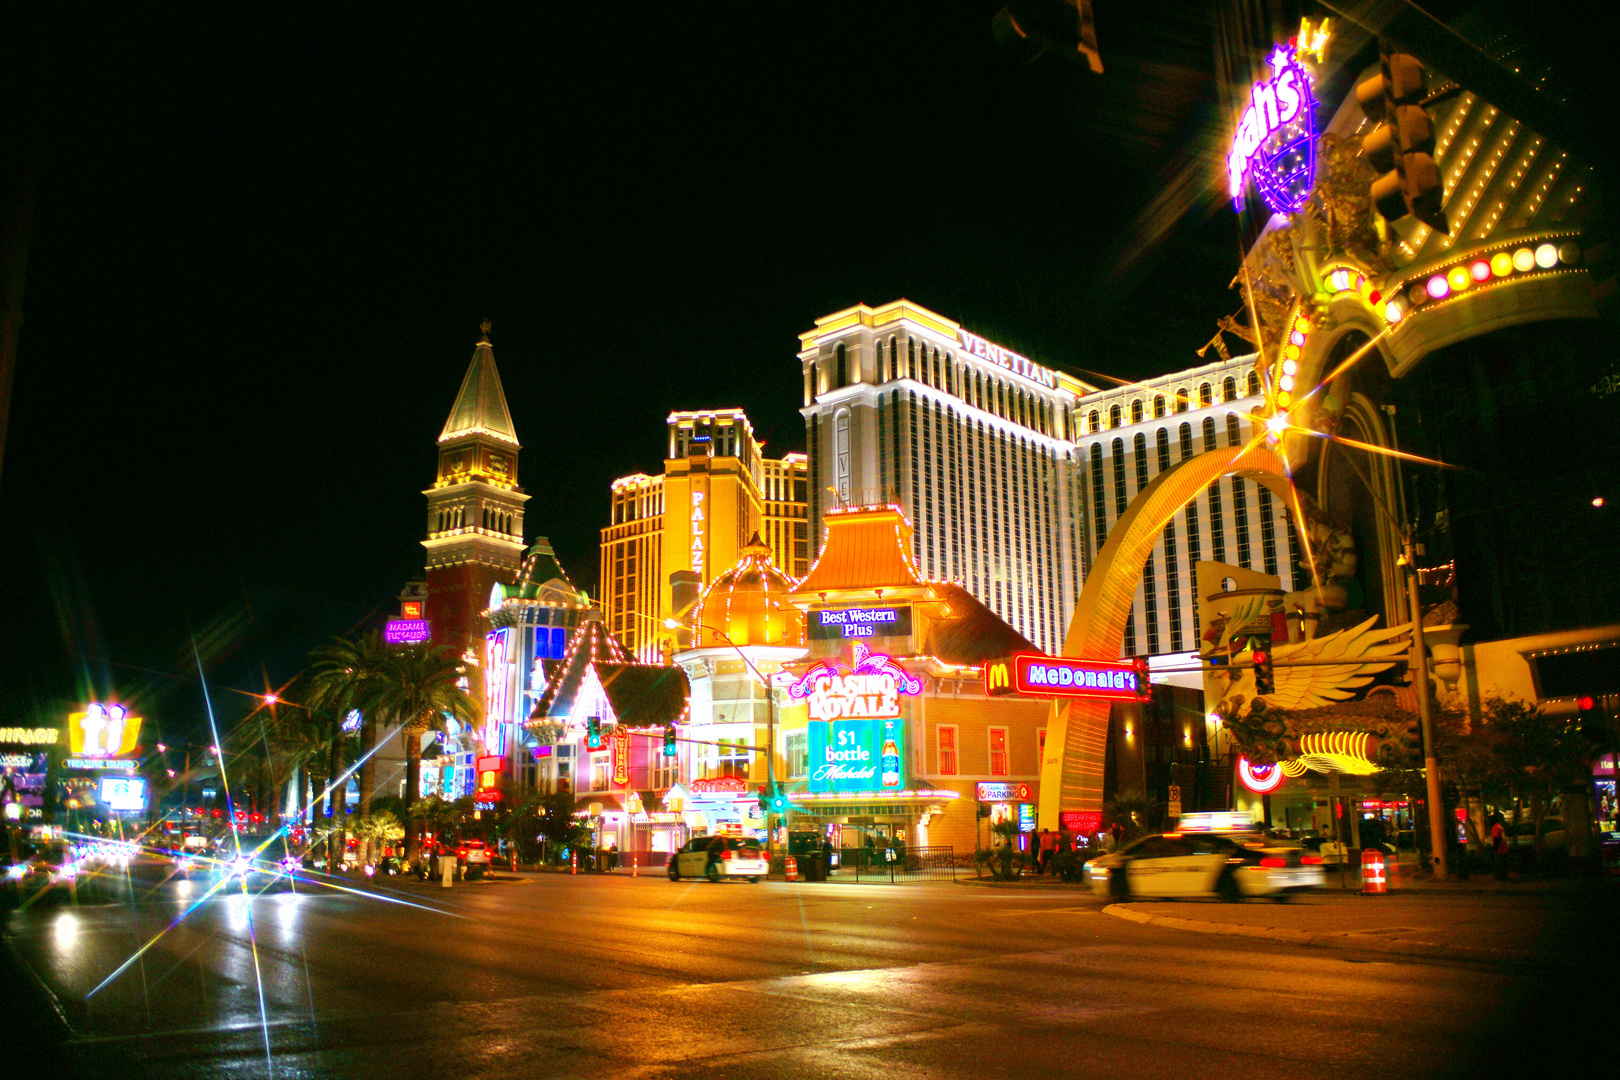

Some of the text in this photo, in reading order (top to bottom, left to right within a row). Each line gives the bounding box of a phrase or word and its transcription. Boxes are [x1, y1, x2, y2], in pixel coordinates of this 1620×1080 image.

[960, 329, 1054, 390] VENETIAN
[821, 607, 896, 624] Best Western
[389, 622, 425, 631] MADAME
[844, 623, 873, 636] Plus
[815, 674, 894, 698] CASINO
[1029, 665, 1136, 690] McDonald's
[808, 690, 899, 720] ROYALE
[838, 730, 855, 746] $1
[826, 745, 870, 762] bottle
[67, 759, 136, 769] TREASURE ISLAND
[813, 763, 877, 780] Michelob
[692, 782, 746, 793] OUTBACK
[988, 790, 1019, 798] PARKING
